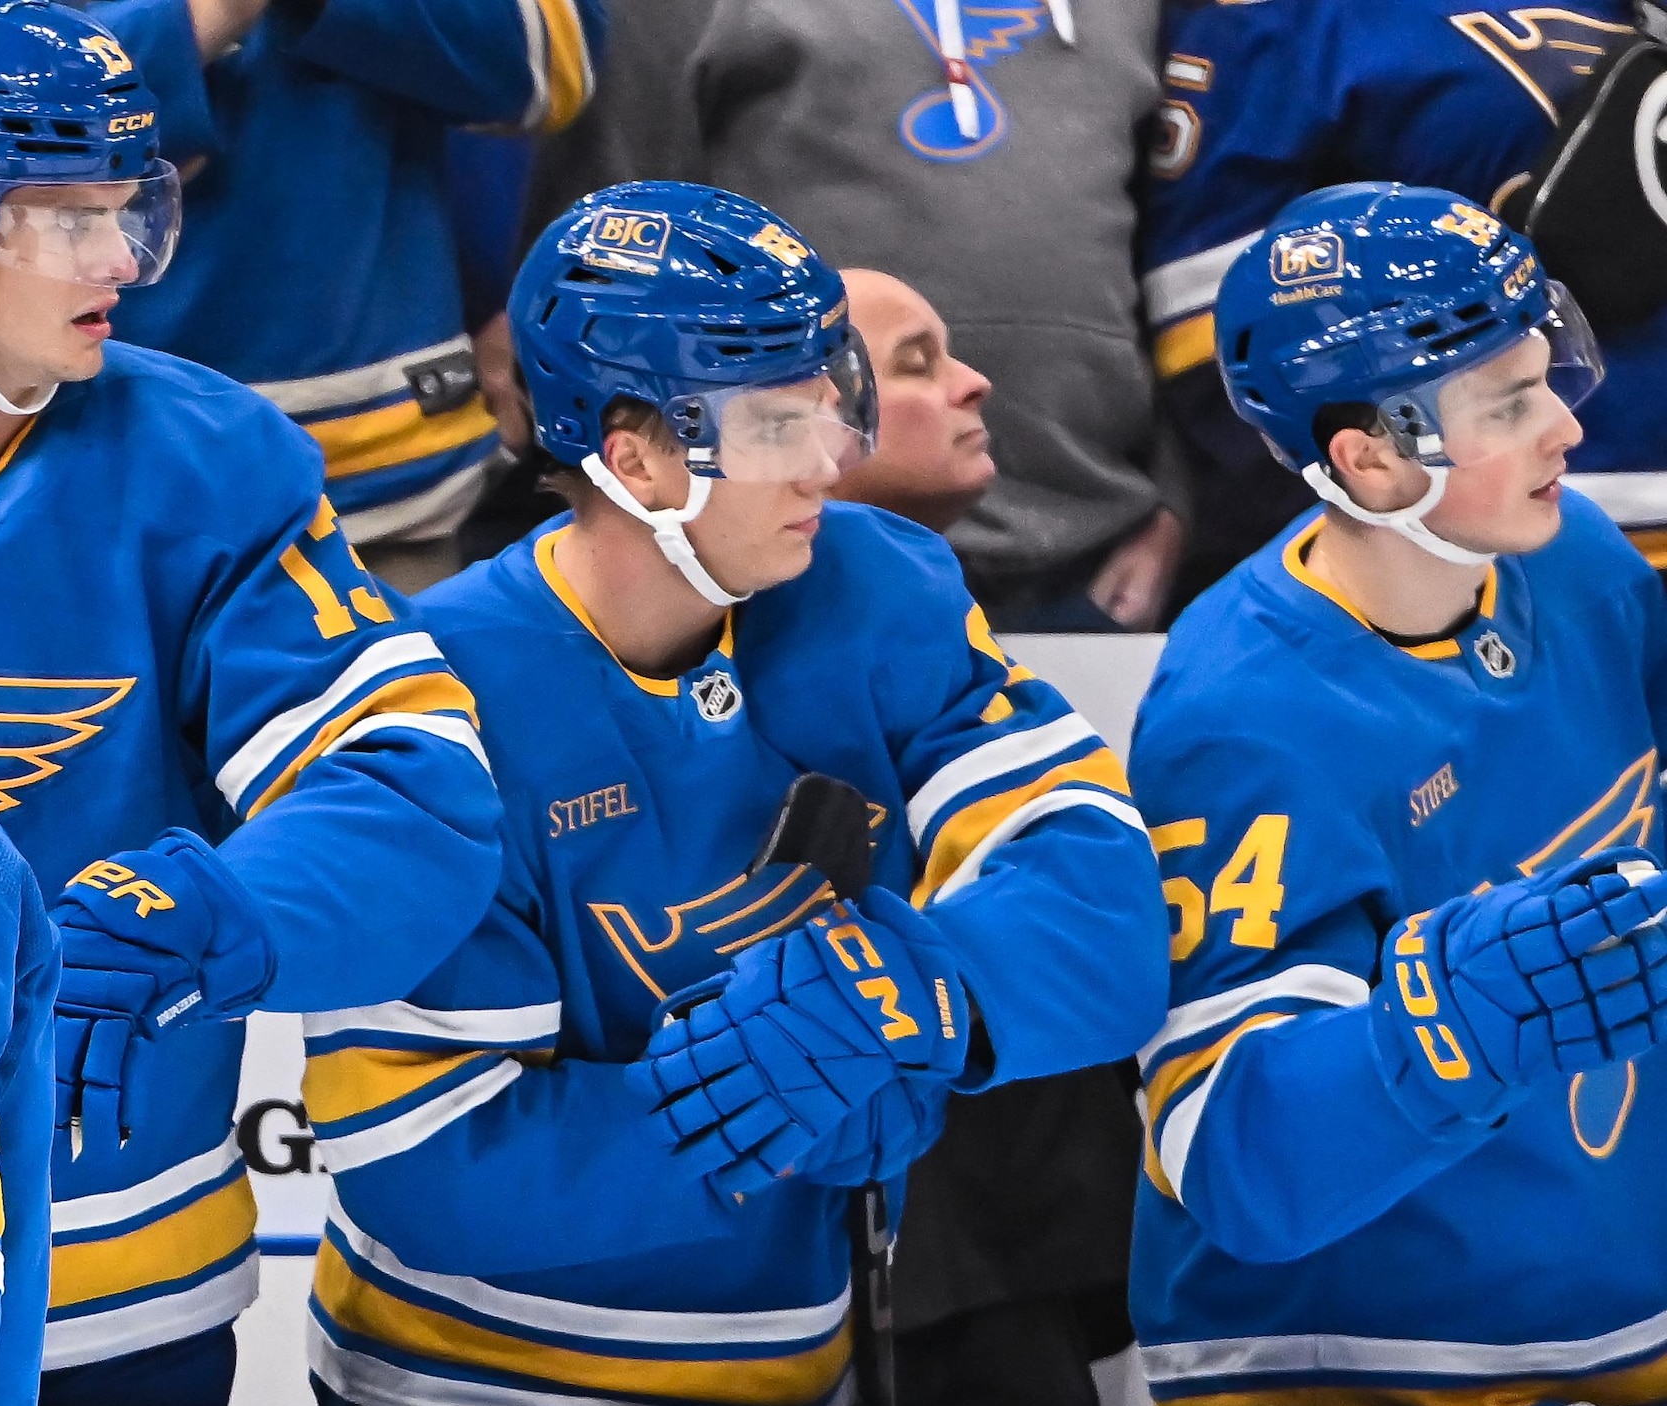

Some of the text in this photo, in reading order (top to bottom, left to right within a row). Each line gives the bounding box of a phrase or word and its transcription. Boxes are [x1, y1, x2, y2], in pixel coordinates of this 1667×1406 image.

[107, 112, 156, 134] CCM
[600, 217, 660, 247] BJC
[548, 782, 639, 838] STIFEL
[812, 900, 920, 1041] CM
